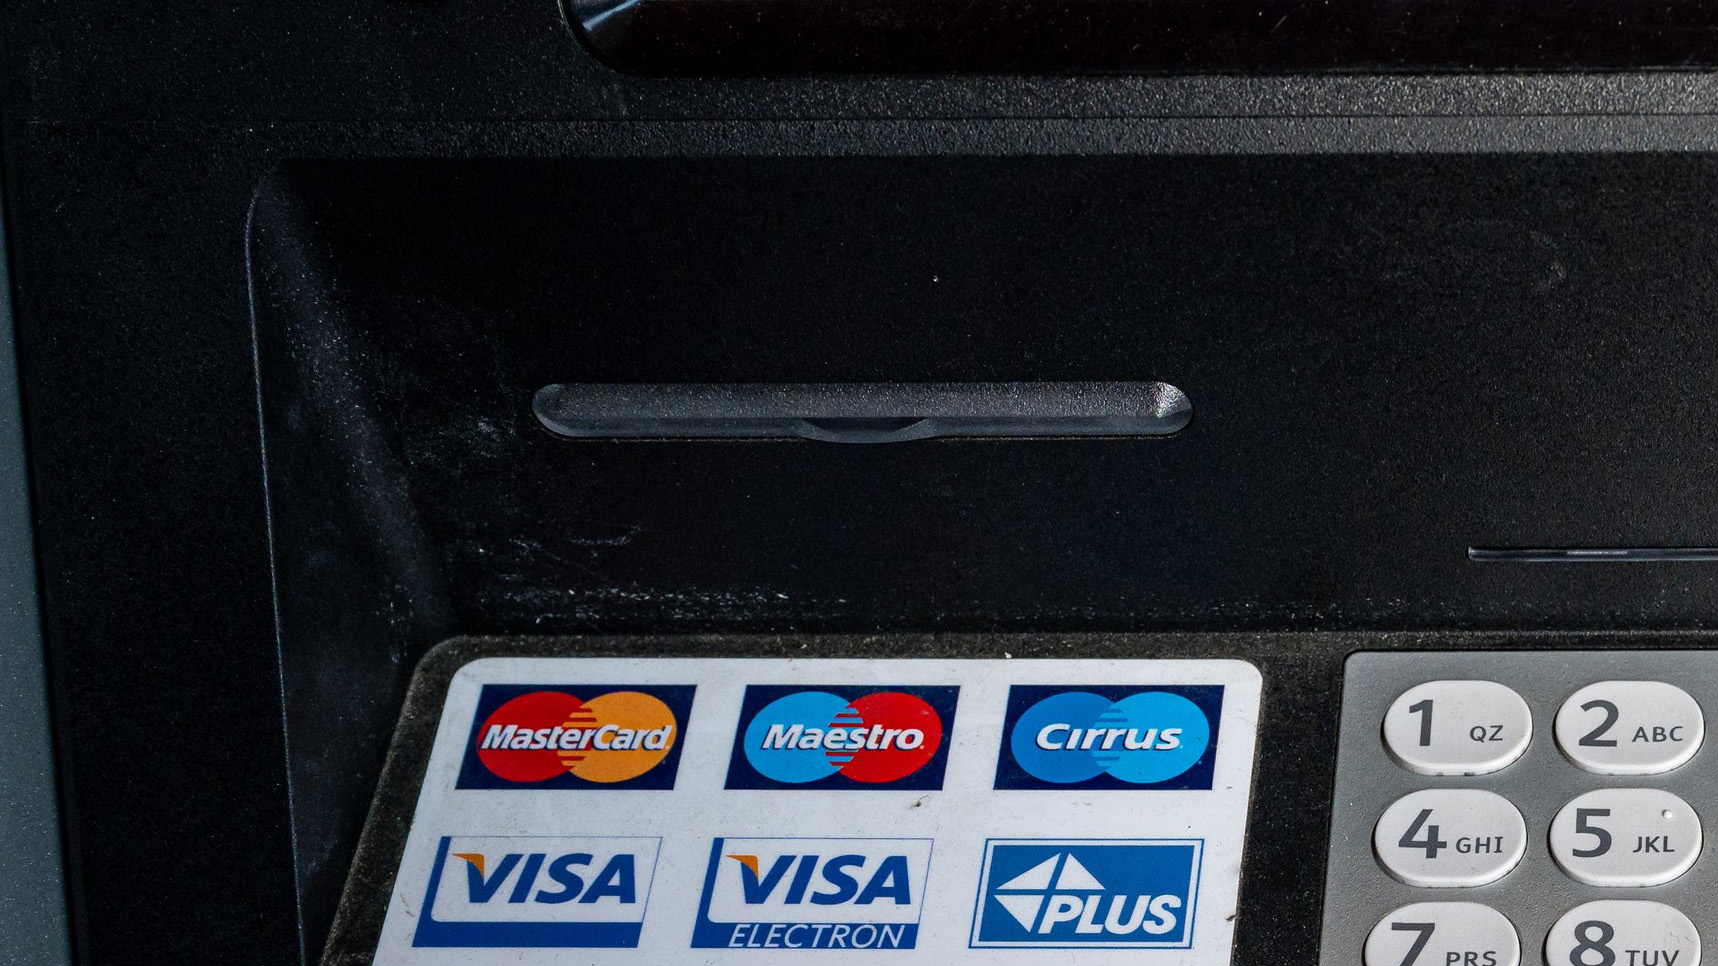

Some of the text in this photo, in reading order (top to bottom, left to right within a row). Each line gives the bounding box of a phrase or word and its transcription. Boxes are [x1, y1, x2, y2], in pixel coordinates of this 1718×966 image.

[482, 725, 672, 749] MasterCard
[763, 725, 922, 749] Maestro
[1037, 724, 1181, 749] Cirrus
[1410, 700, 1503, 746] 1 QZ
[1579, 700, 1682, 747] 2 ABC
[1399, 809, 1503, 858] 4 GHI
[1573, 808, 1675, 857] 5 JKL
[453, 853, 636, 904] VISA
[727, 855, 911, 905] VISA
[1038, 895, 1181, 934] PLUS
[730, 925, 902, 947] ELECTRON
[1625, 950, 1679, 966] TUV
